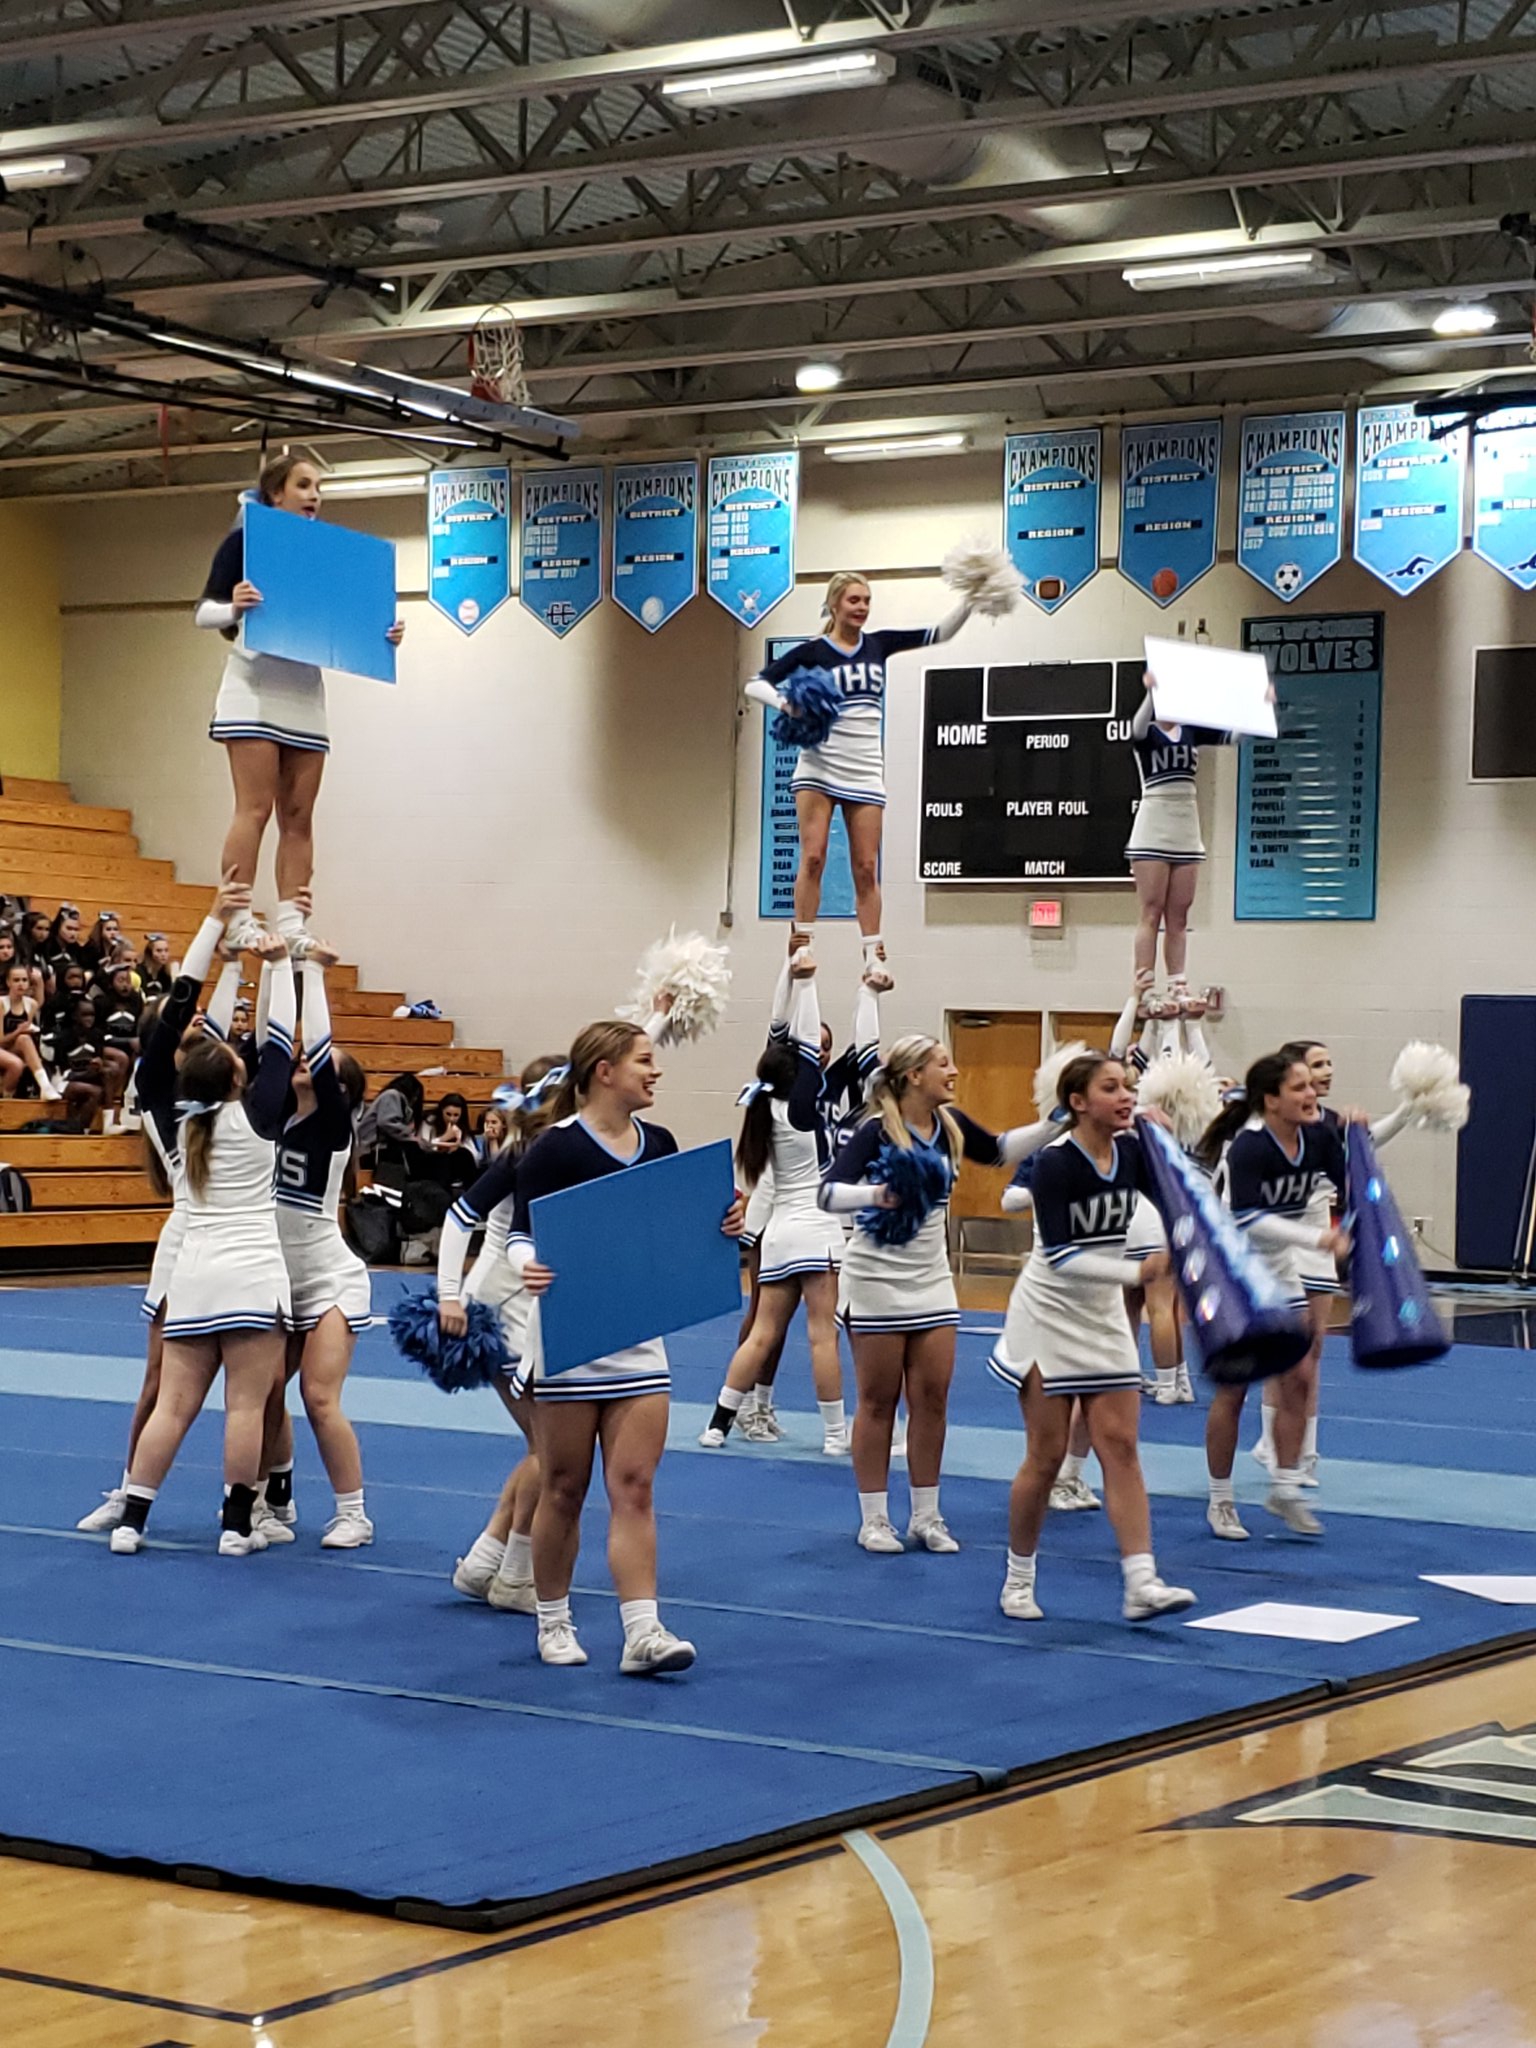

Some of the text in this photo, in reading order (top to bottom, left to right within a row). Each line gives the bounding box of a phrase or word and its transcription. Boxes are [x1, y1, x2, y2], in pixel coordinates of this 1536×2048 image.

[1245, 427, 1340, 472] CHAMPIONS
[1126, 436, 1216, 480] CHAMPIONS
[1010, 445, 1096, 488] CHAMPIONS
[1261, 464, 1324, 475] DISTRICT
[1141, 472, 1200, 485] DISTRICT
[712, 468, 790, 507] CHAMPIONS
[1023, 480, 1081, 492] DISTRICT
[434, 481, 506, 518] CHAMPIONS
[525, 482, 598, 520] CHAMPIONS
[617, 476, 693, 514] CHAMPIONS
[724, 501, 777, 512] DISTRICT
[445, 513, 493, 524] DISTRICT
[537, 514, 586, 524] DISTRICT
[629, 508, 680, 519] DISTRICT
[1265, 513, 1316, 524] REGION
[1145, 520, 1192, 531] REGION
[1028, 528, 1074, 539] REGION
[541, 559, 581, 568] REGION
[634, 553, 675, 562] REGION
[937, 725, 987, 745] HOME
[1026, 734, 1069, 749] PERIOD
[925, 803, 963, 817] FOULS
[1006, 801, 1089, 816] PLAYER FOUL
[1252, 802, 1285, 811] POWELL
[1262, 844, 1289, 854] SMITH
[923, 862, 962, 876] SCORE
[1024, 861, 1065, 875] MATCH
